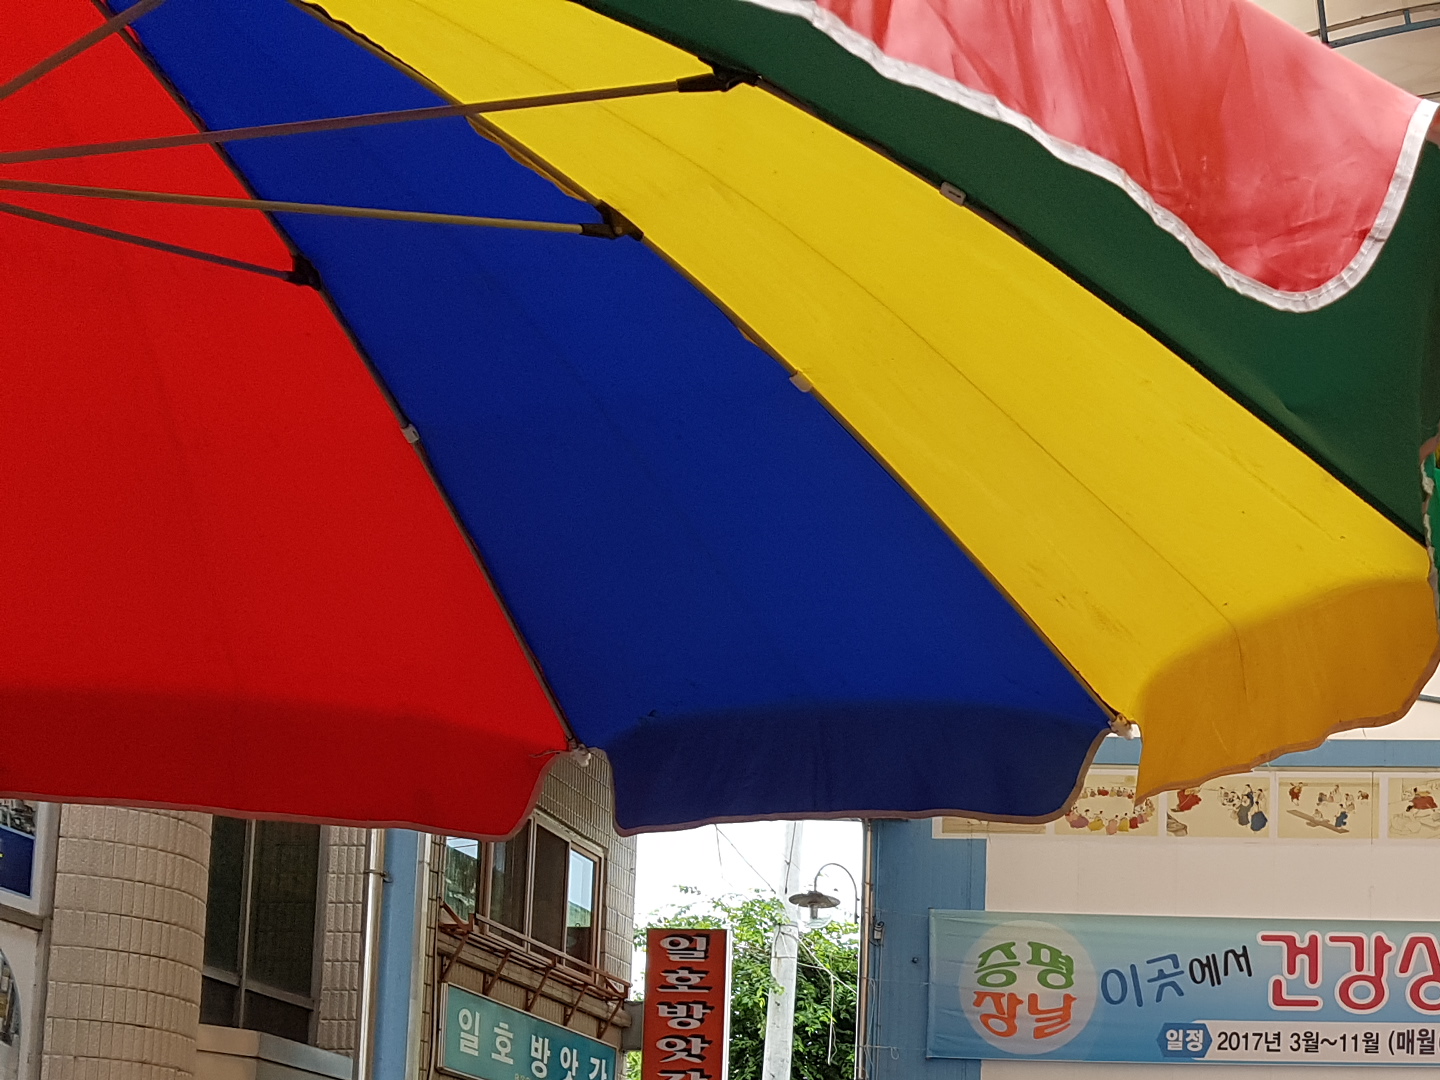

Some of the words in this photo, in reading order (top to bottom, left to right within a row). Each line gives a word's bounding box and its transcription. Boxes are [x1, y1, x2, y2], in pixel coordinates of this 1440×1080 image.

[974, 940, 1075, 990] 증평
[1100, 945, 1253, 1008] 이곳에서
[972, 991, 1076, 1040] 장날
[1164, 1027, 1204, 1052] 일정
[1216, 1030, 1283, 1054] 2017년
[1289, 1031, 1381, 1055] 3월~11월
